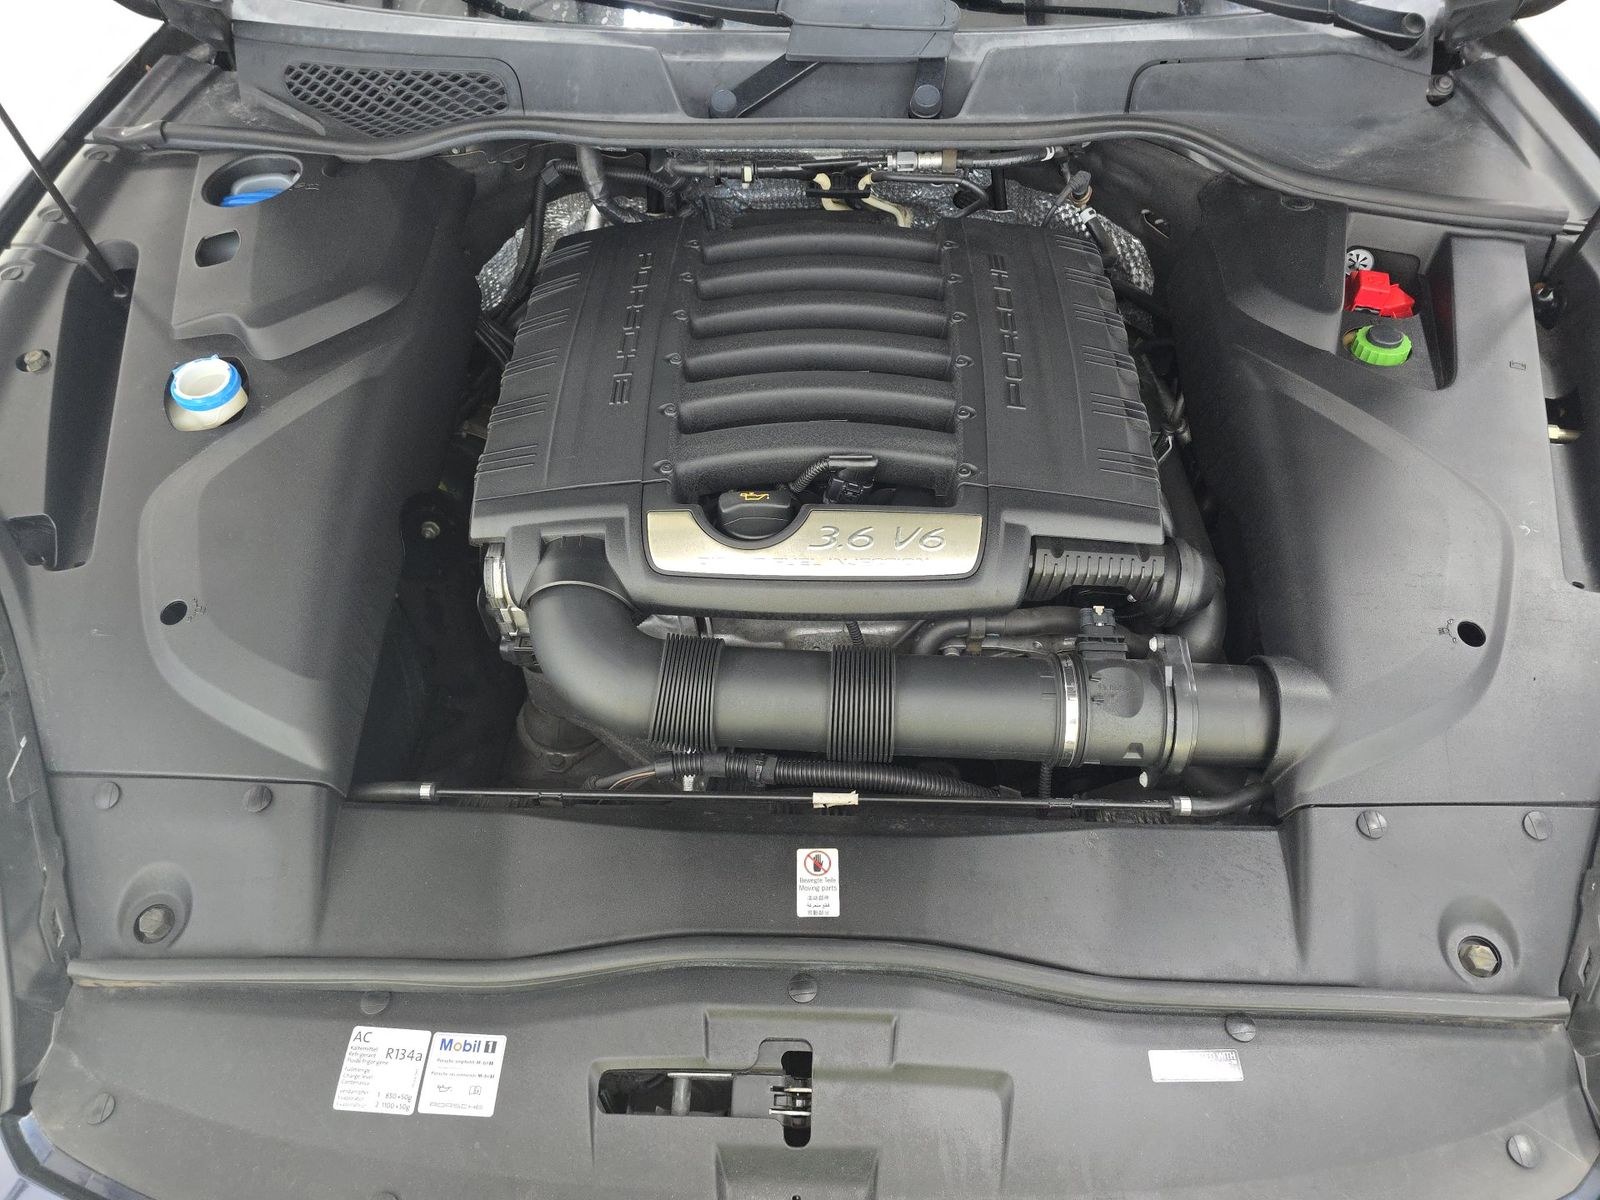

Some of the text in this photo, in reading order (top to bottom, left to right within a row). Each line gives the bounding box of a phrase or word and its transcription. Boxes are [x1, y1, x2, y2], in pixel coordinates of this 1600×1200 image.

[609, 252, 652, 405] PORSCHE
[988, 253, 1027, 410] PORSCHE
[808, 526, 946, 551] 3.6 V6
[352, 1031, 373, 1043] AC
[440, 1038, 481, 1053] Mobil
[385, 1047, 423, 1061] R134a
